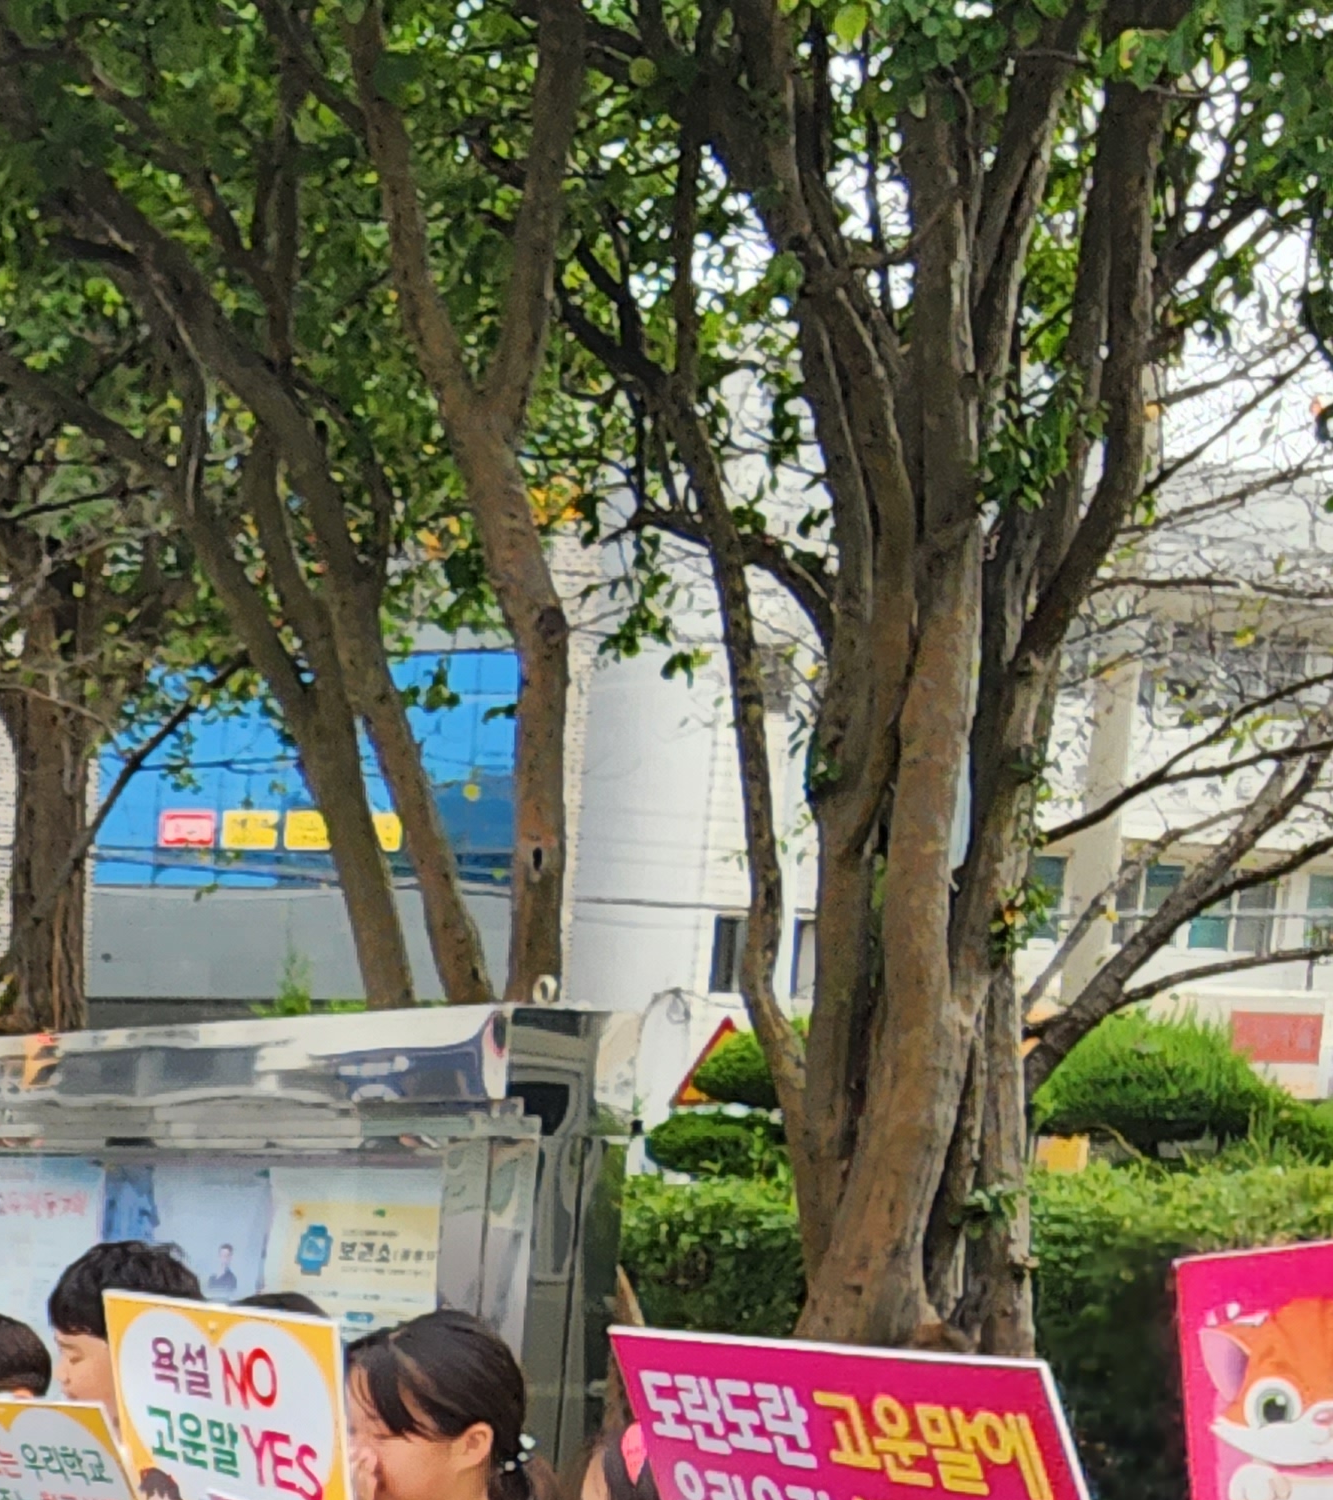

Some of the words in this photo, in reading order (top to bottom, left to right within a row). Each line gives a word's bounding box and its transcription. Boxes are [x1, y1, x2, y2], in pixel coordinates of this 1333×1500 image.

[150, 1336, 212, 1400] 욕설
[217, 1346, 279, 1410] NO
[146, 1404, 241, 1481] 고운말
[638, 1368, 818, 1469] 도란도란
[19, 1443, 115, 1486] 우리학교
